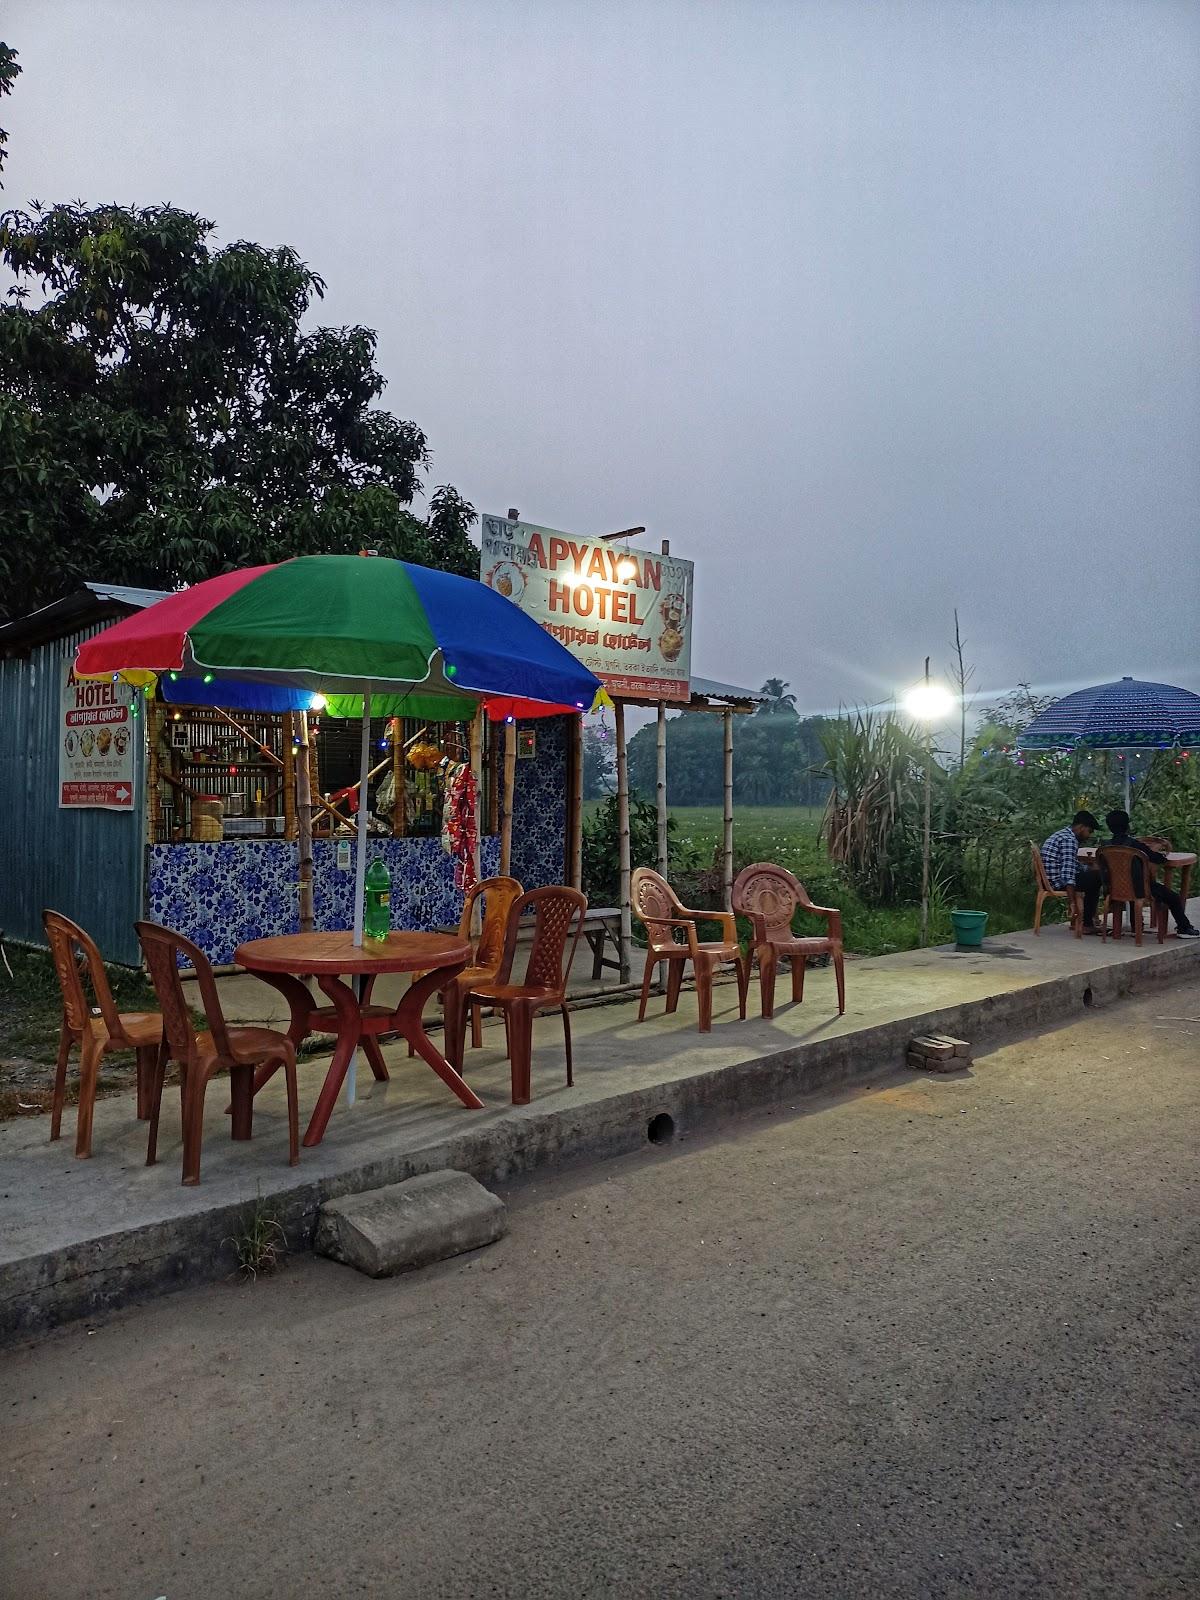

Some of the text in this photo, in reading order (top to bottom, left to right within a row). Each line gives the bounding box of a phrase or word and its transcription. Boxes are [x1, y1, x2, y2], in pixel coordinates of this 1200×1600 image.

[528, 533, 662, 592] APYAYAN
[548, 578, 645, 625] HOTEL
[603, 632, 652, 653] হোটেল
[76, 683, 118, 707] HOTEL
